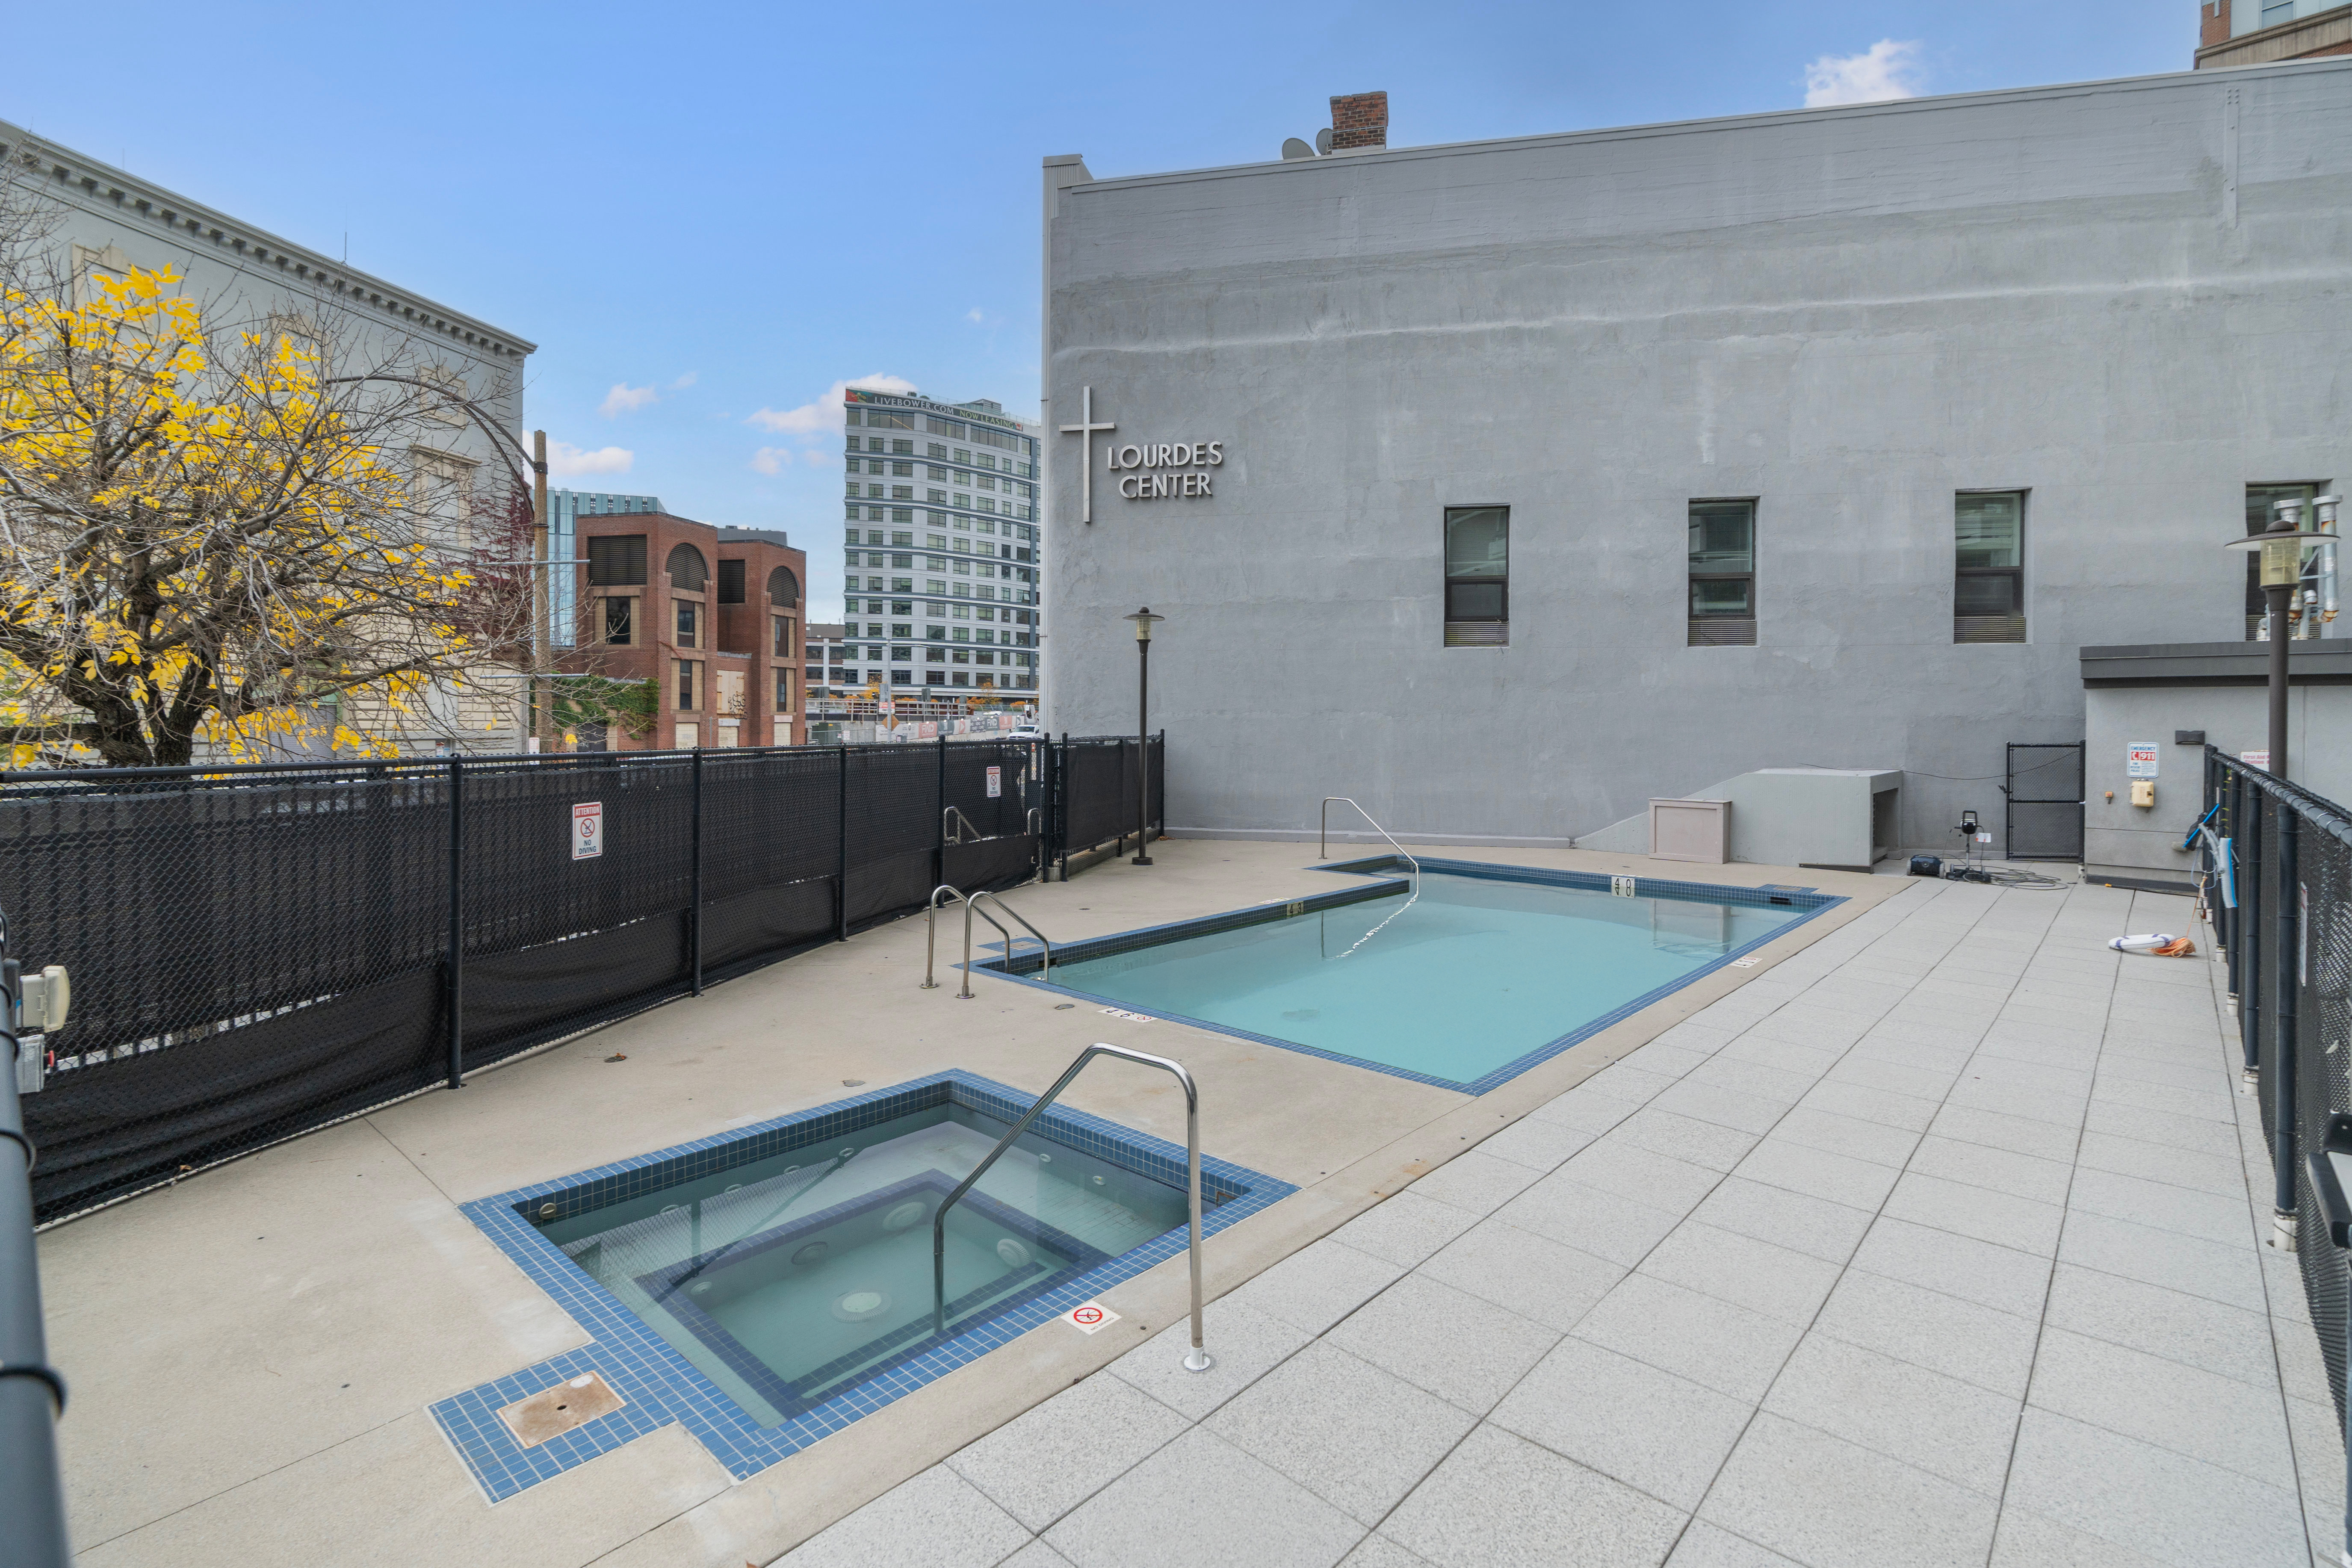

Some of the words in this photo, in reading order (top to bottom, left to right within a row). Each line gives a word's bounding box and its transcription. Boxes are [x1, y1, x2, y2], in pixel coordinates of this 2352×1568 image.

[875, 396, 954, 415] LIVEBOWER.COM
[960, 410, 979, 420] NOW
[981, 416, 1013, 429] LEASING
[1108, 441, 1222, 469] LOURDES
[1119, 472, 1212, 499] CENTER
[576, 806, 600, 816] ATTENTION
[579, 846, 597, 854] DIVING
[1098, 1317, 1114, 1326] DIVING
